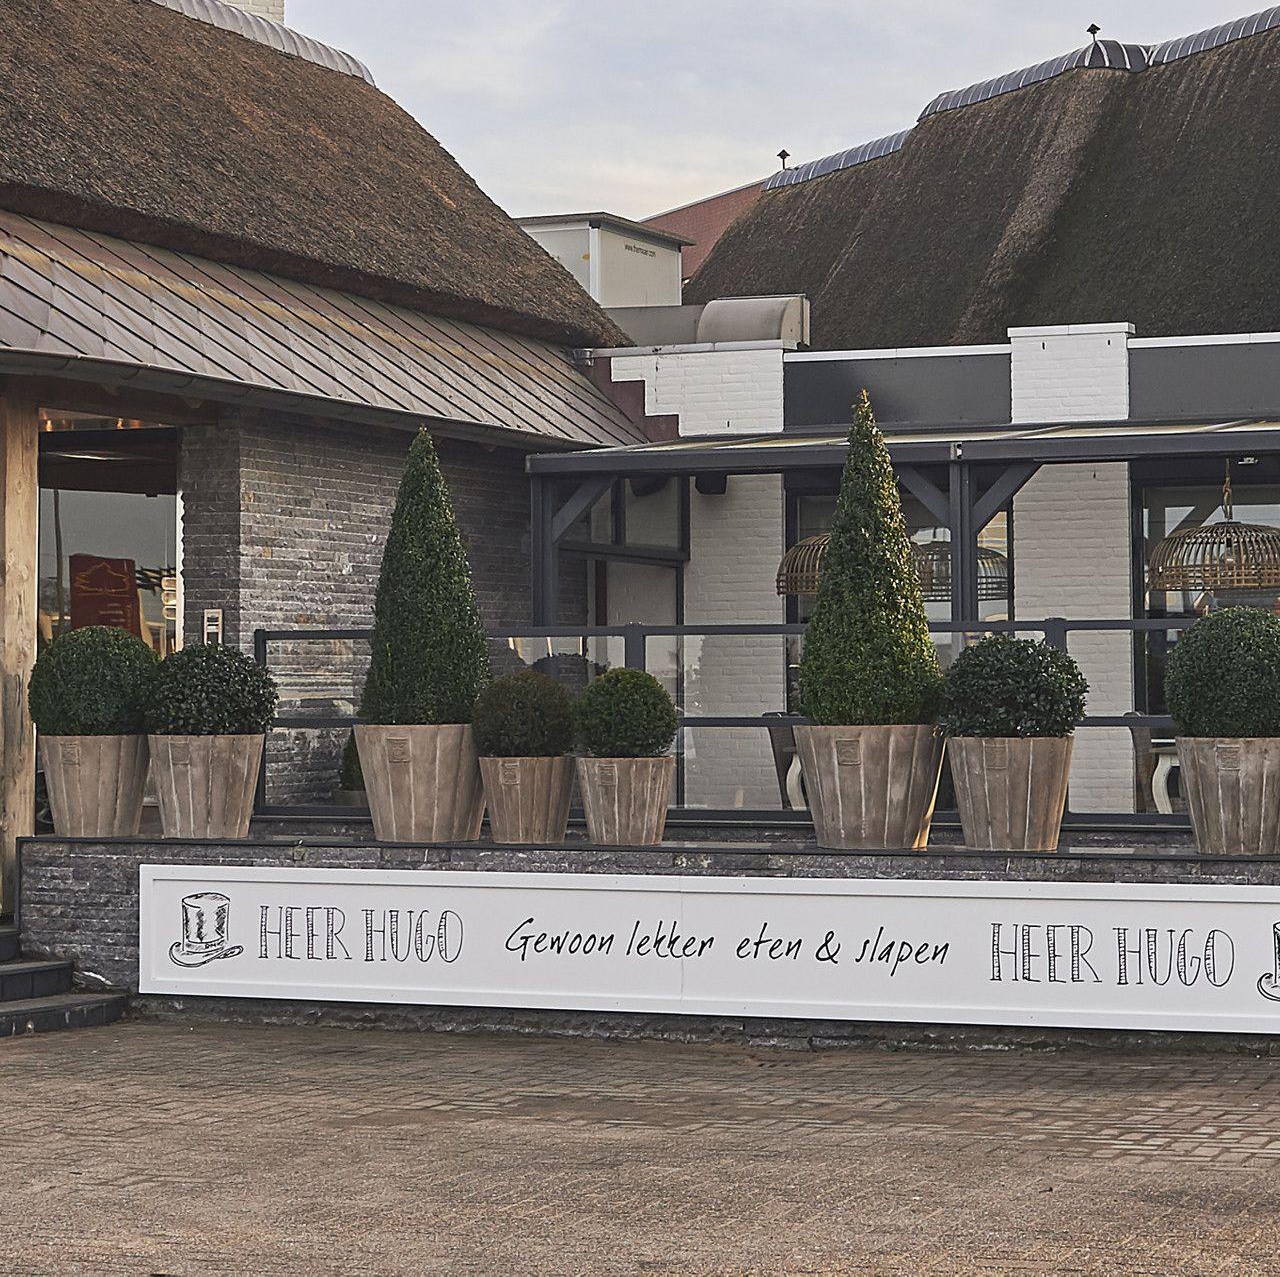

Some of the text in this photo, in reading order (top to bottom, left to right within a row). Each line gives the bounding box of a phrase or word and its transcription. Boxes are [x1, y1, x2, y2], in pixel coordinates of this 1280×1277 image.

[258, 906, 463, 963] HEER HUGO
[505, 918, 949, 977] Gewoon lekker eten & slapen
[990, 923, 1234, 987] HEER HUGO
